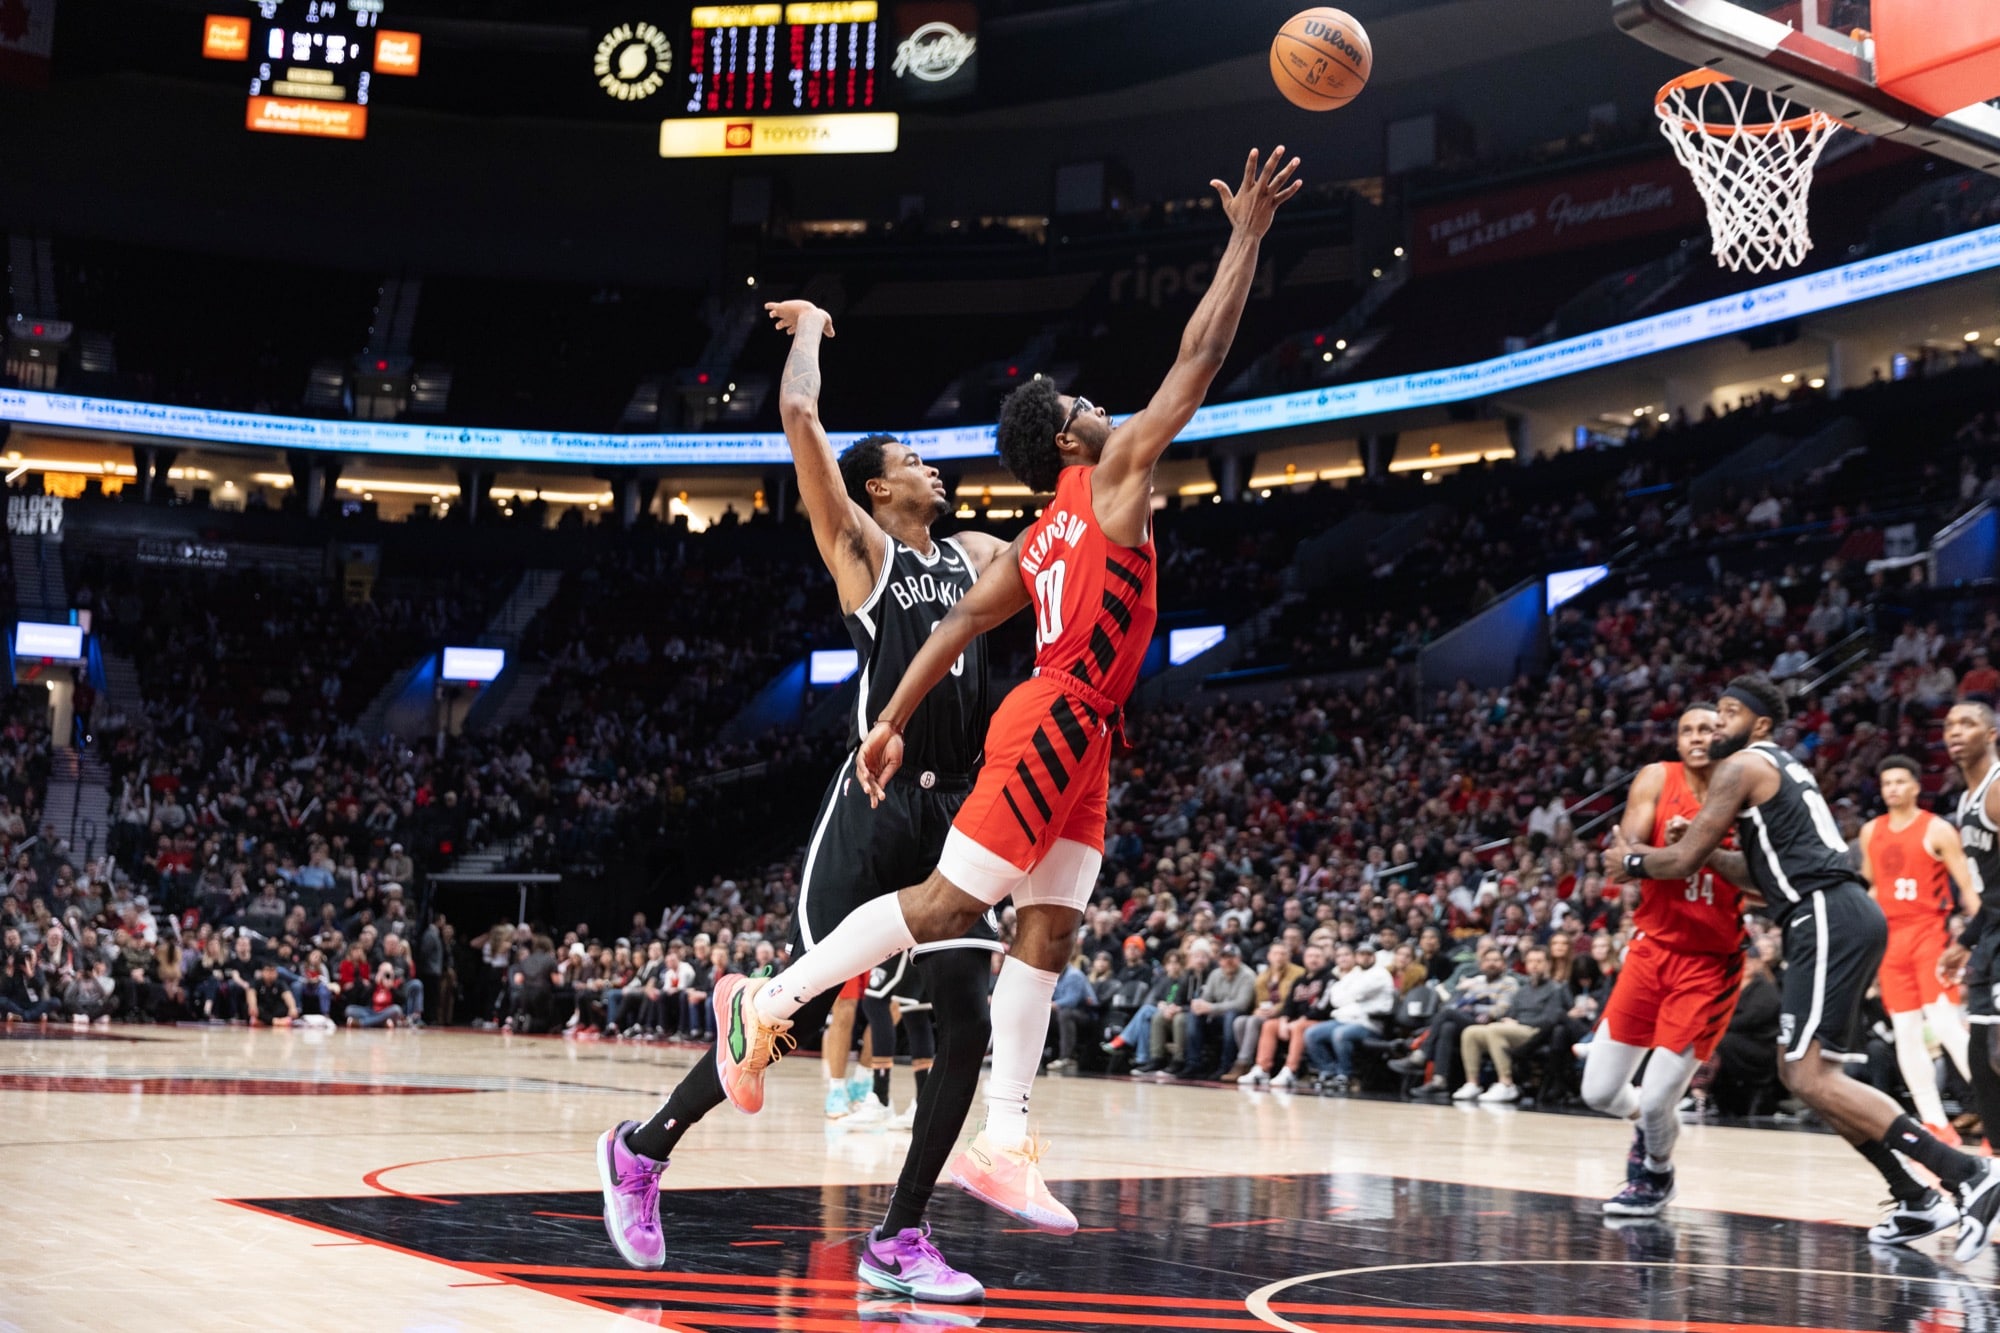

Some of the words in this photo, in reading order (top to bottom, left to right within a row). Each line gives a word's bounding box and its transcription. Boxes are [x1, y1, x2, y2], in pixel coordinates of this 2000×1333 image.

[1304, 20, 1362, 66] Wilson
[761, 127, 831, 141] TOYOTA
[8, 495, 64, 514] BLOCK
[6, 512, 64, 535] PARTY
[195, 545, 228, 560] Tech
[1685, 872, 1714, 906] 34
[1894, 877, 1918, 901] 33
